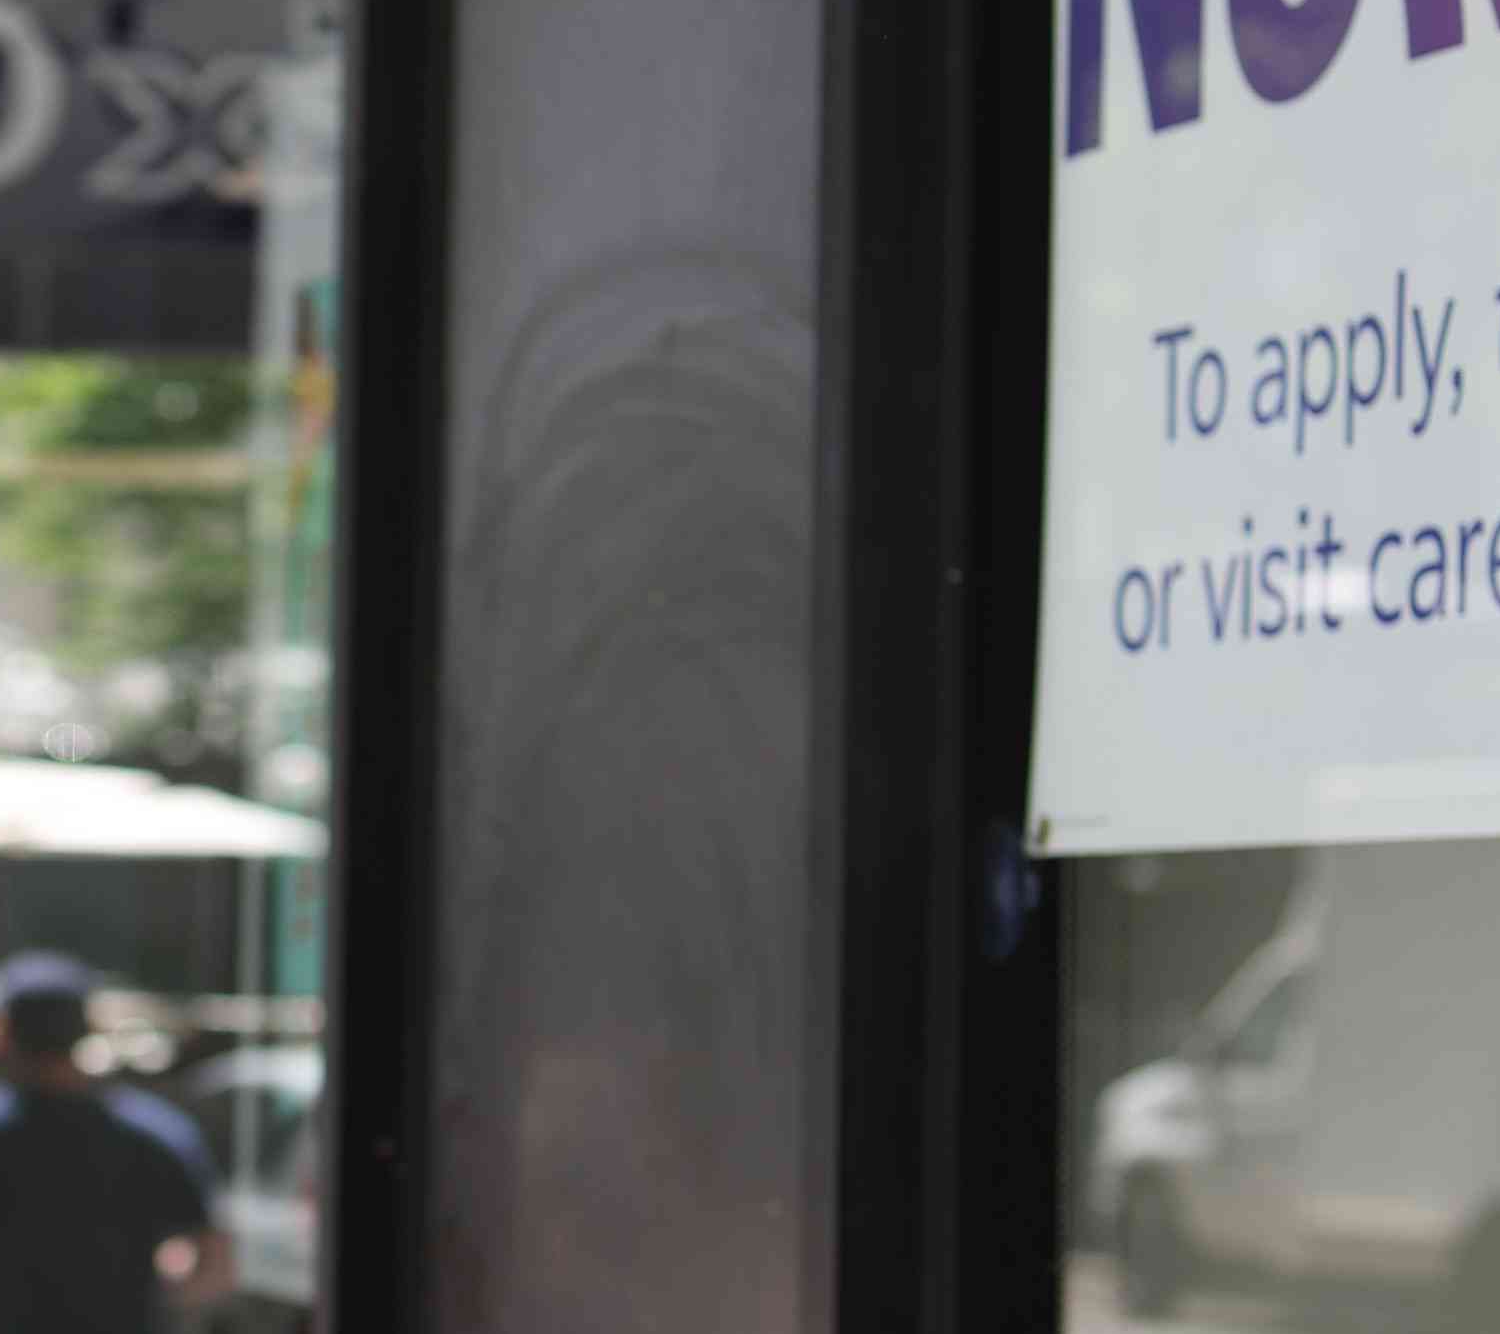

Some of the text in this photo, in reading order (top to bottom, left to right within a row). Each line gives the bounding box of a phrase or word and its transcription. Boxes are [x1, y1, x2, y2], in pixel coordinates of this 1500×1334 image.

[1154, 325, 1228, 448] To
[1249, 270, 1465, 453] apply,
[1112, 565, 1182, 655] or
[1201, 507, 1344, 645] visit
